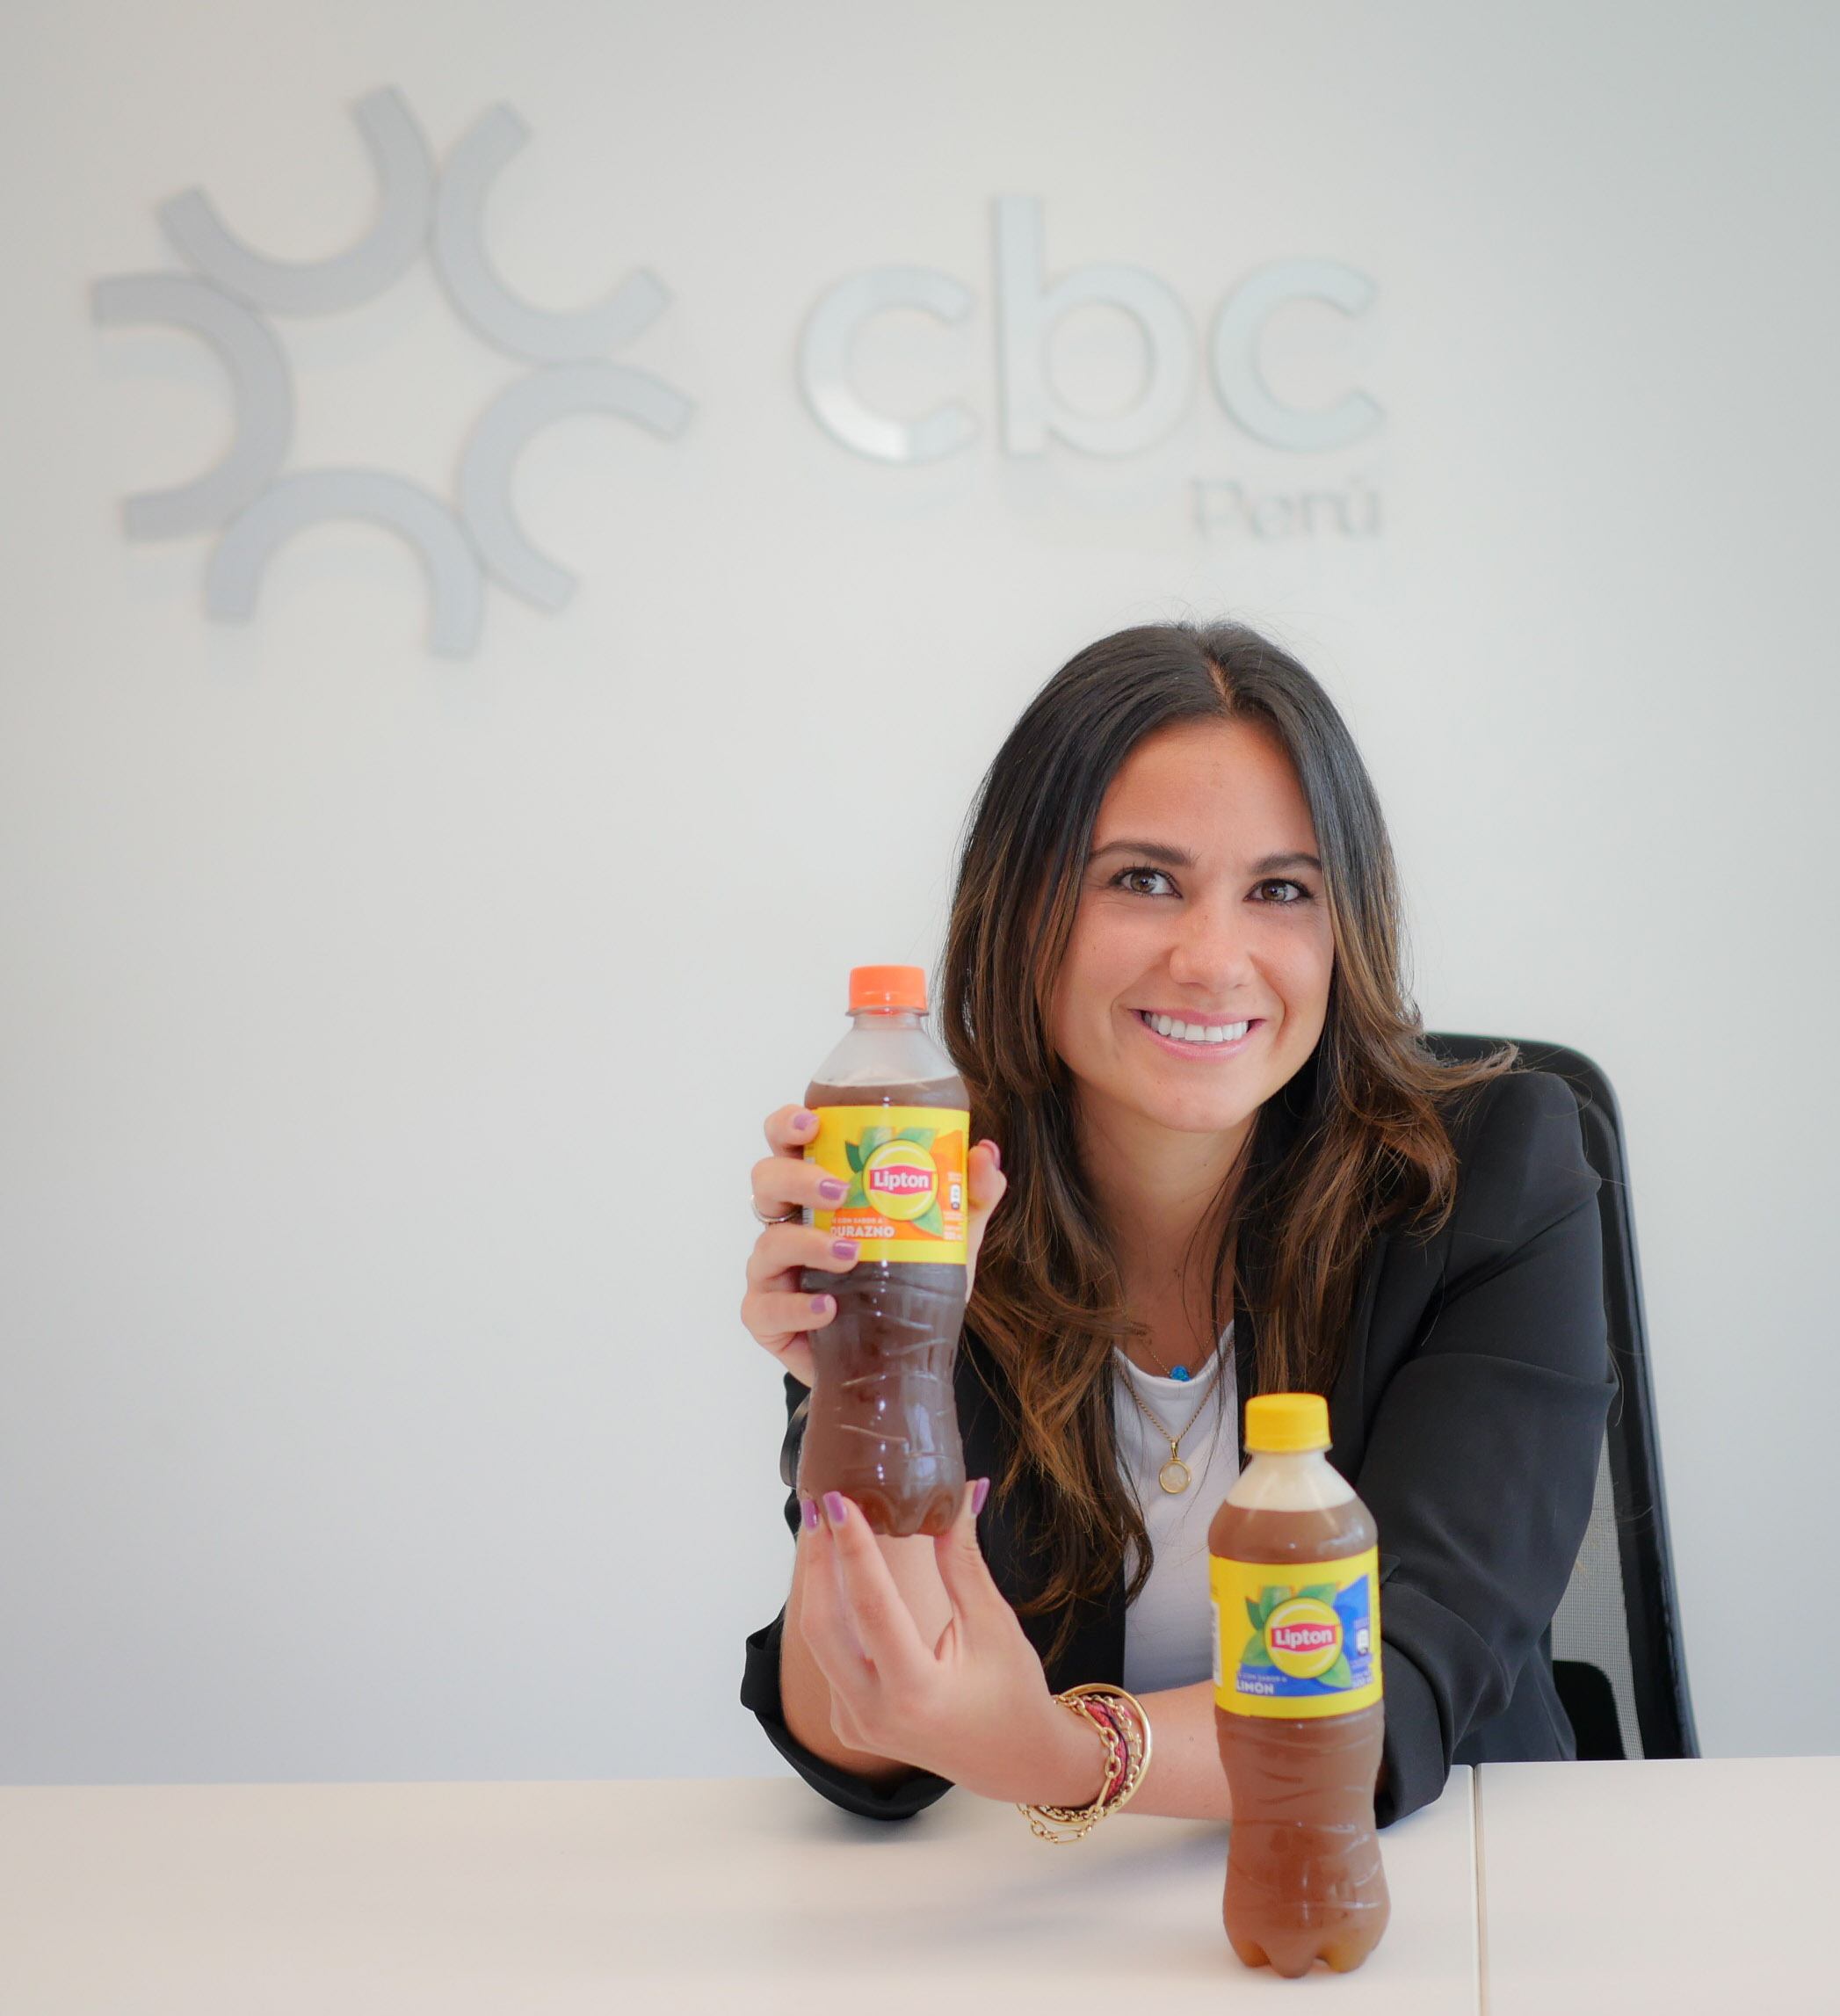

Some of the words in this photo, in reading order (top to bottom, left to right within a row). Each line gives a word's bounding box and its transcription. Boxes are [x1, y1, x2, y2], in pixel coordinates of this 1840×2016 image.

[798, 194, 1384, 463] cbc
[874, 1171, 929, 1190] Lipton
[829, 1225, 895, 1238] DURAZNO
[1275, 1628, 1333, 1648] Lipton
